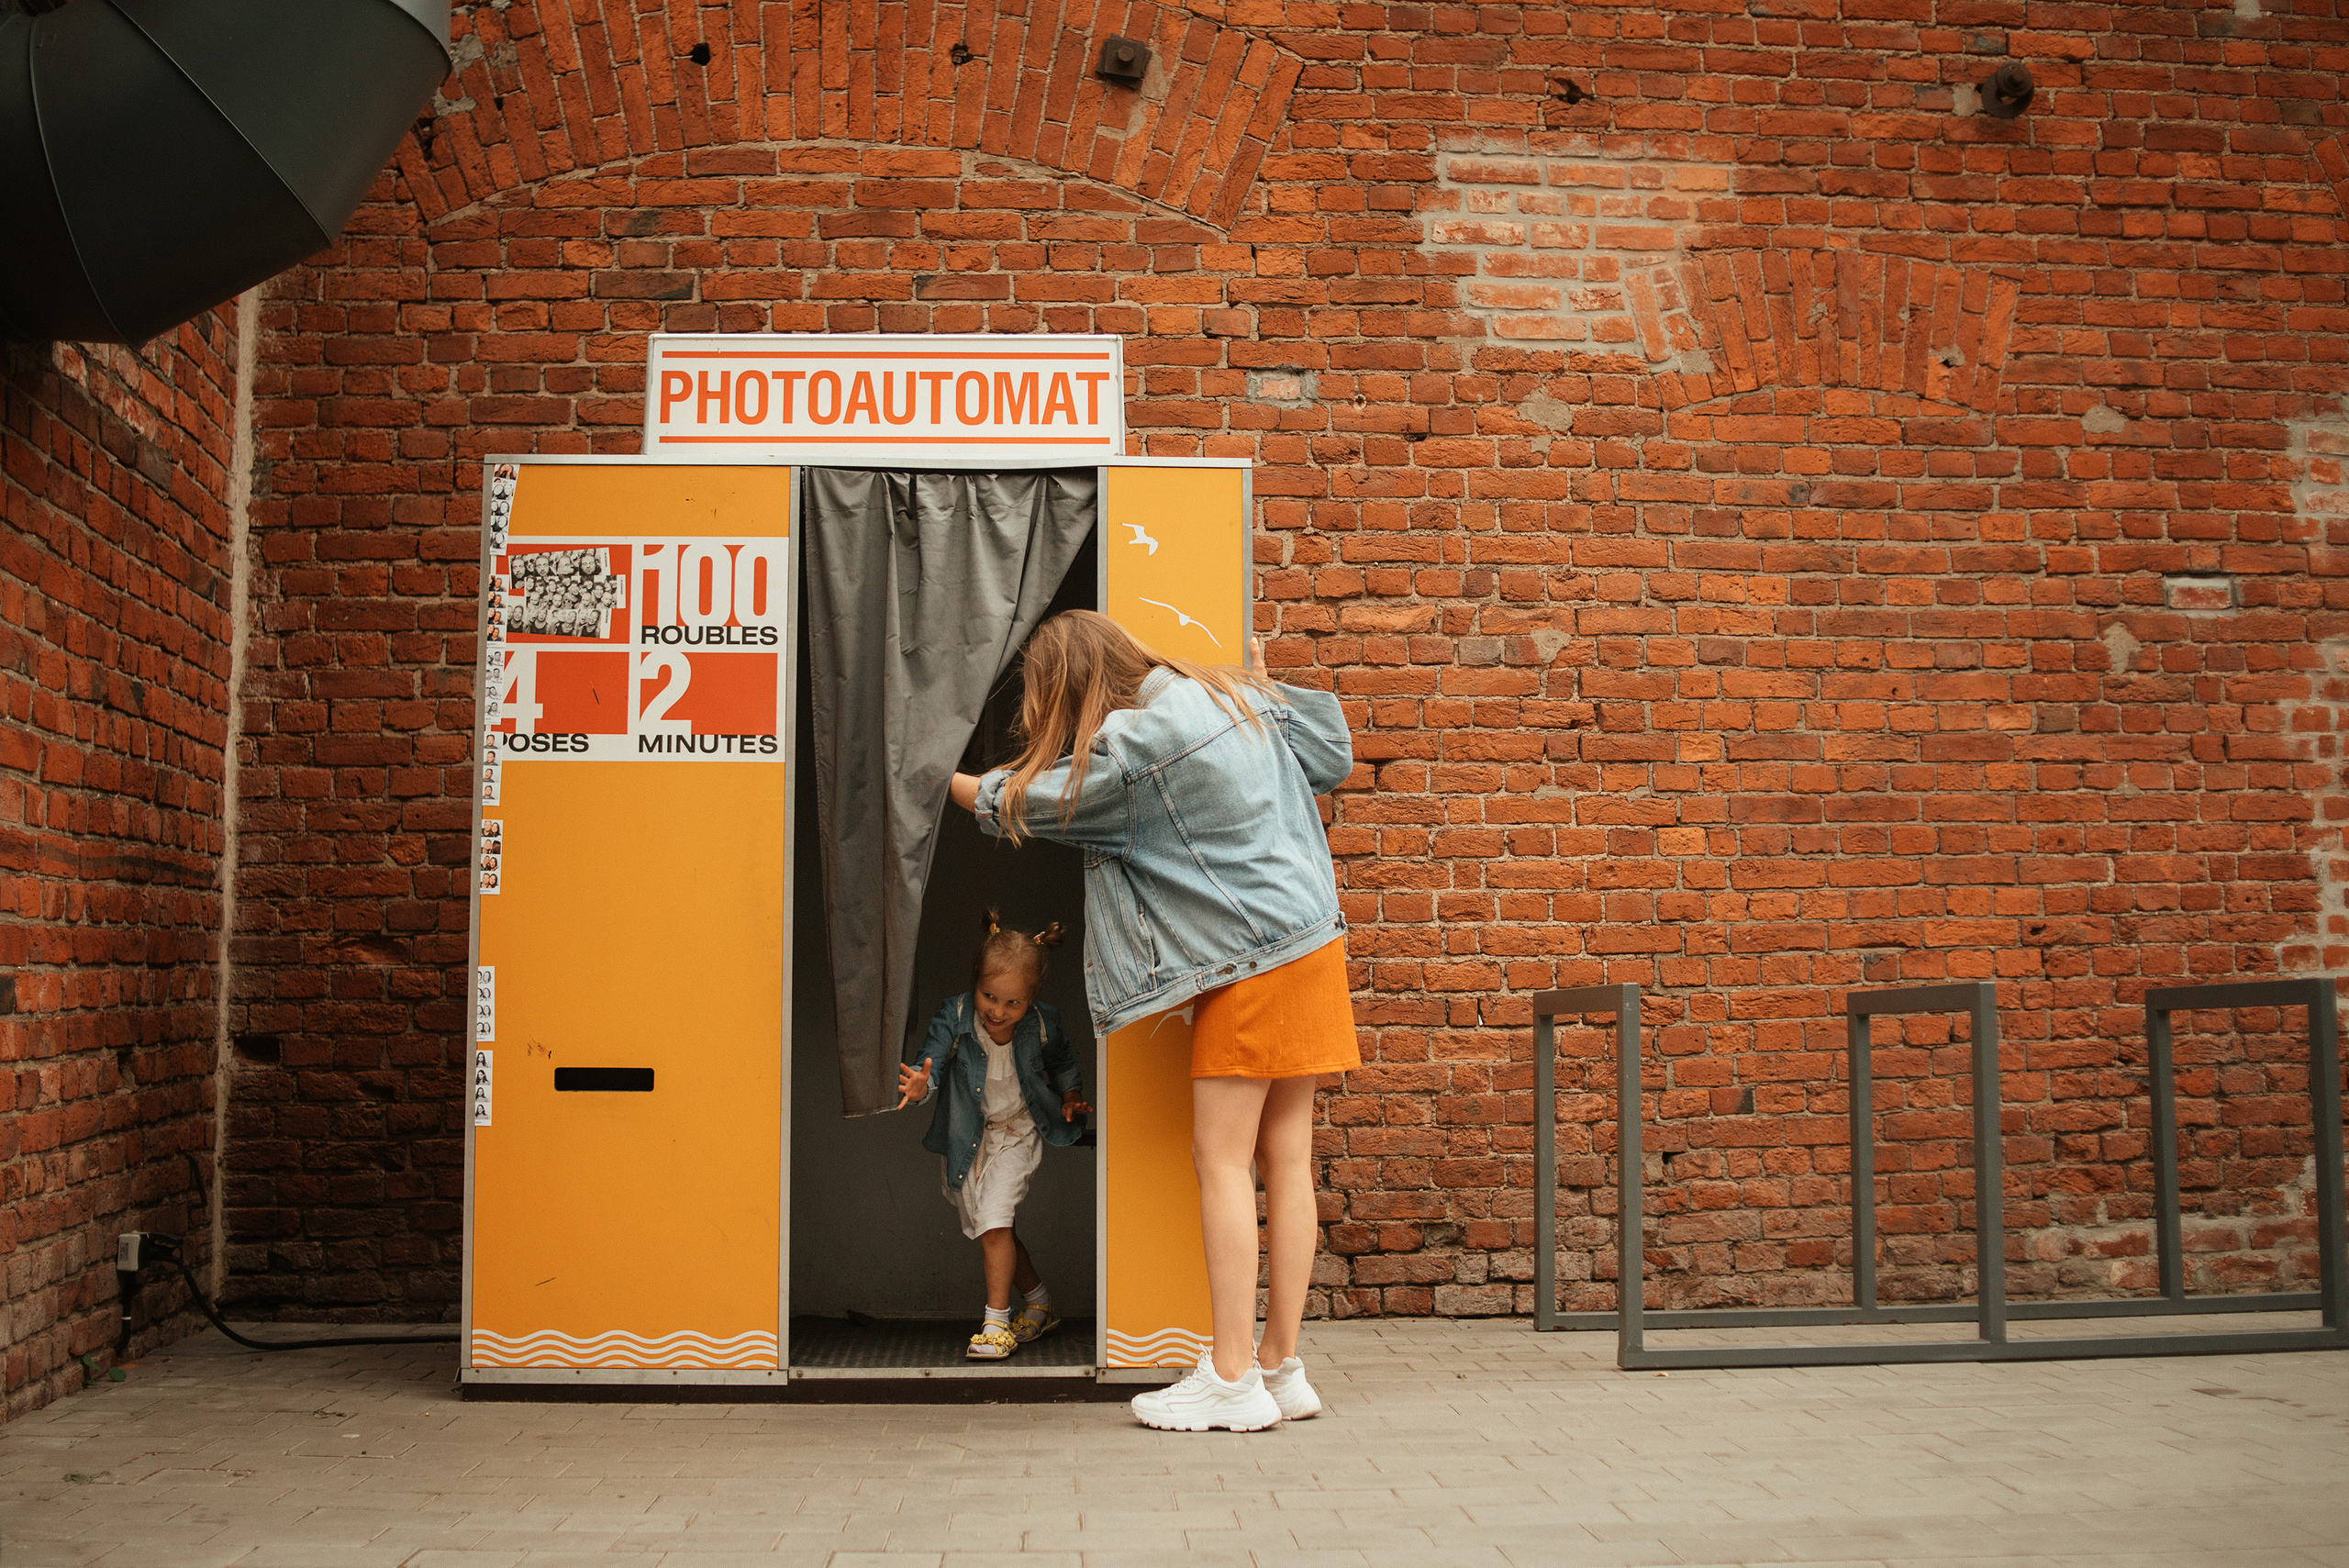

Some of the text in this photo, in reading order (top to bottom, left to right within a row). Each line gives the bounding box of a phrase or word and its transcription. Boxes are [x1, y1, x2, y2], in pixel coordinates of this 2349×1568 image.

[659, 369, 1110, 426] PHOTOAUTOMAT
[642, 543, 783, 628] 100
[640, 625, 779, 646] ROUBLES
[501, 651, 544, 735] 4
[640, 651, 693, 735] 2
[638, 733, 779, 755] MINUTES
